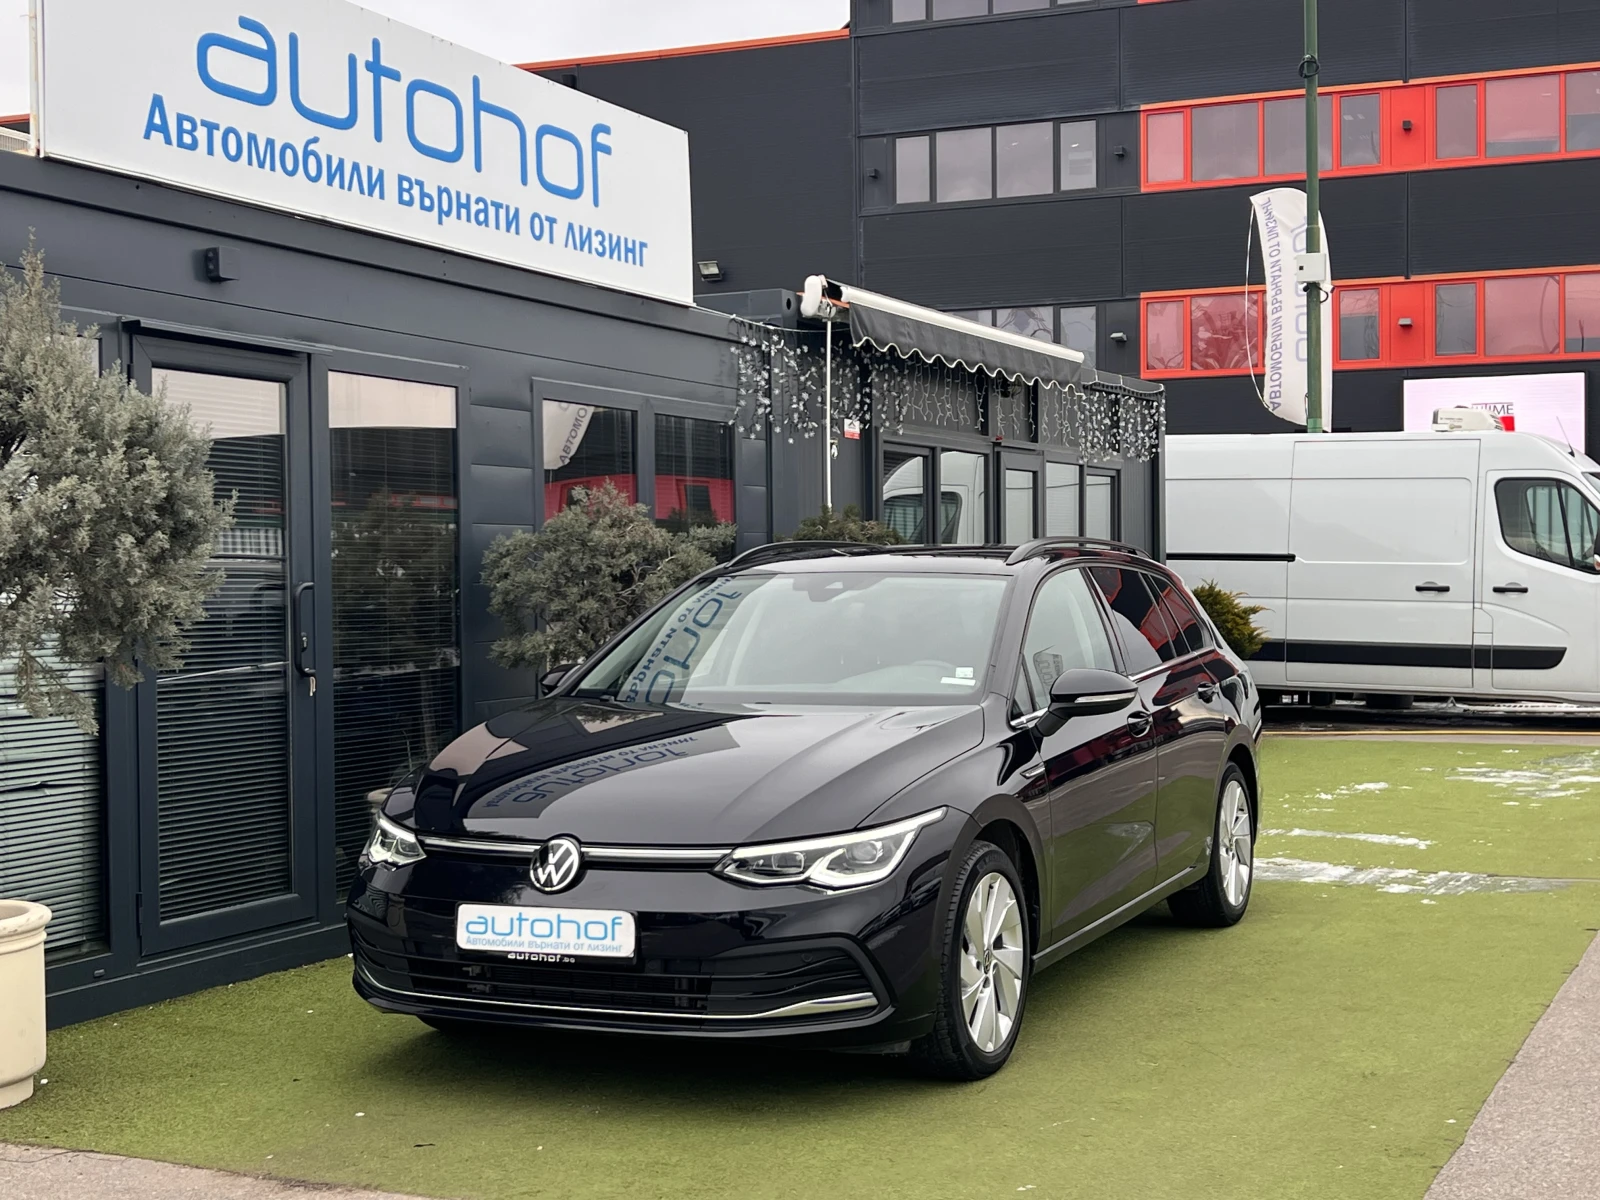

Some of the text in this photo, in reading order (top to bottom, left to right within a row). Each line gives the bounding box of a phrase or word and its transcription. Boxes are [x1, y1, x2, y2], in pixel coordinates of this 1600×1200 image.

[196, 16, 612, 207] autohof
[143, 94, 648, 265] Автомобили върнати от лизинг
[465, 912, 623, 941] autohof
[466, 936, 623, 953] Автомобили върнати от лизинг
